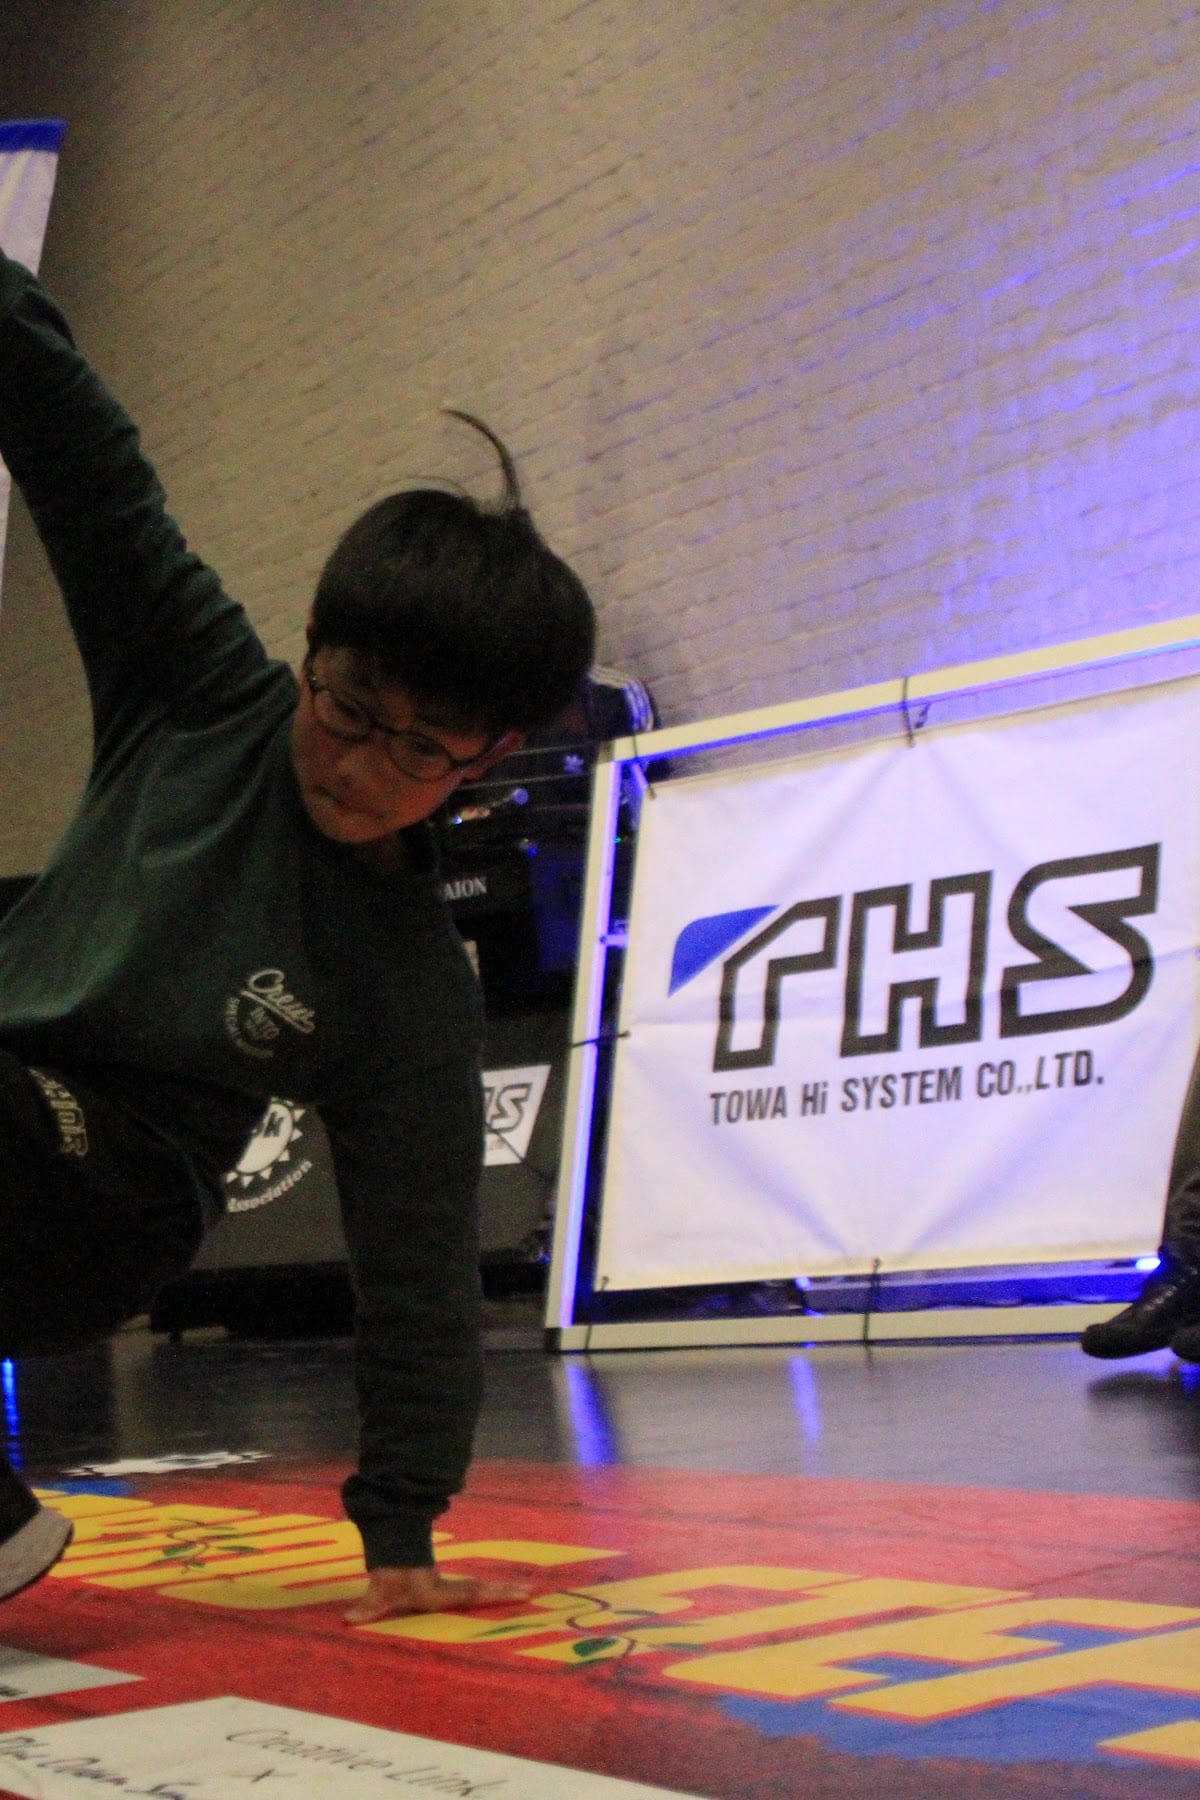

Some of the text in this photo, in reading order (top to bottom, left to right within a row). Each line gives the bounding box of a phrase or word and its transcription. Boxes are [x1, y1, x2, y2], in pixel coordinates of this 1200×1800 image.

[710, 1086, 789, 1126] TOWA
[801, 1081, 829, 1115] Hi
[841, 1065, 963, 1112] SYSTEM
